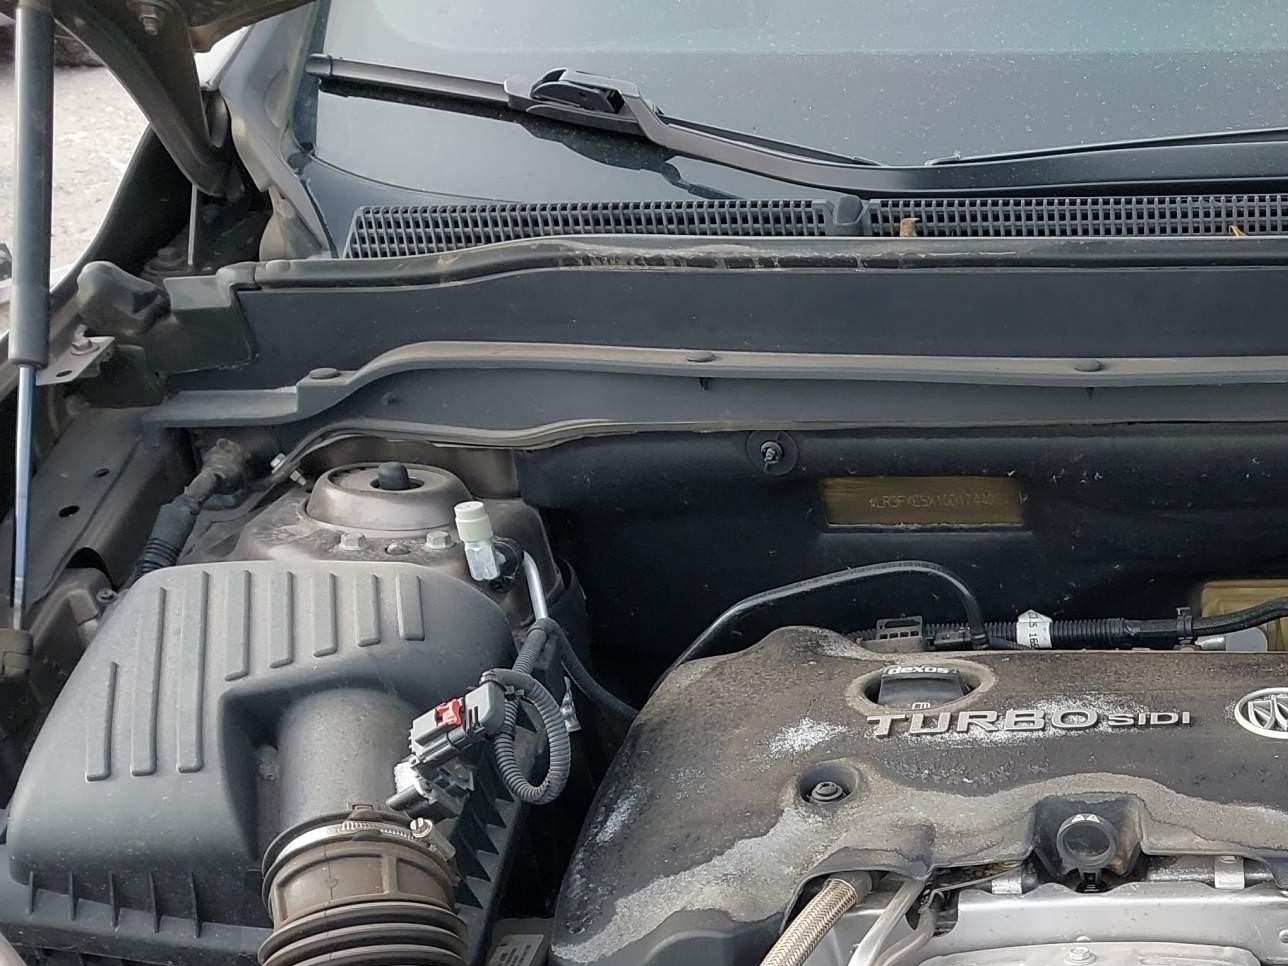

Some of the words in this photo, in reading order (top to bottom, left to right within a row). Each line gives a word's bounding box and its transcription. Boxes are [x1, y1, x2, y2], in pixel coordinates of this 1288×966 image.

[887, 666, 950, 675] dexos
[867, 709, 1098, 738] TURBO
[1107, 711, 1191, 727] SIDI
